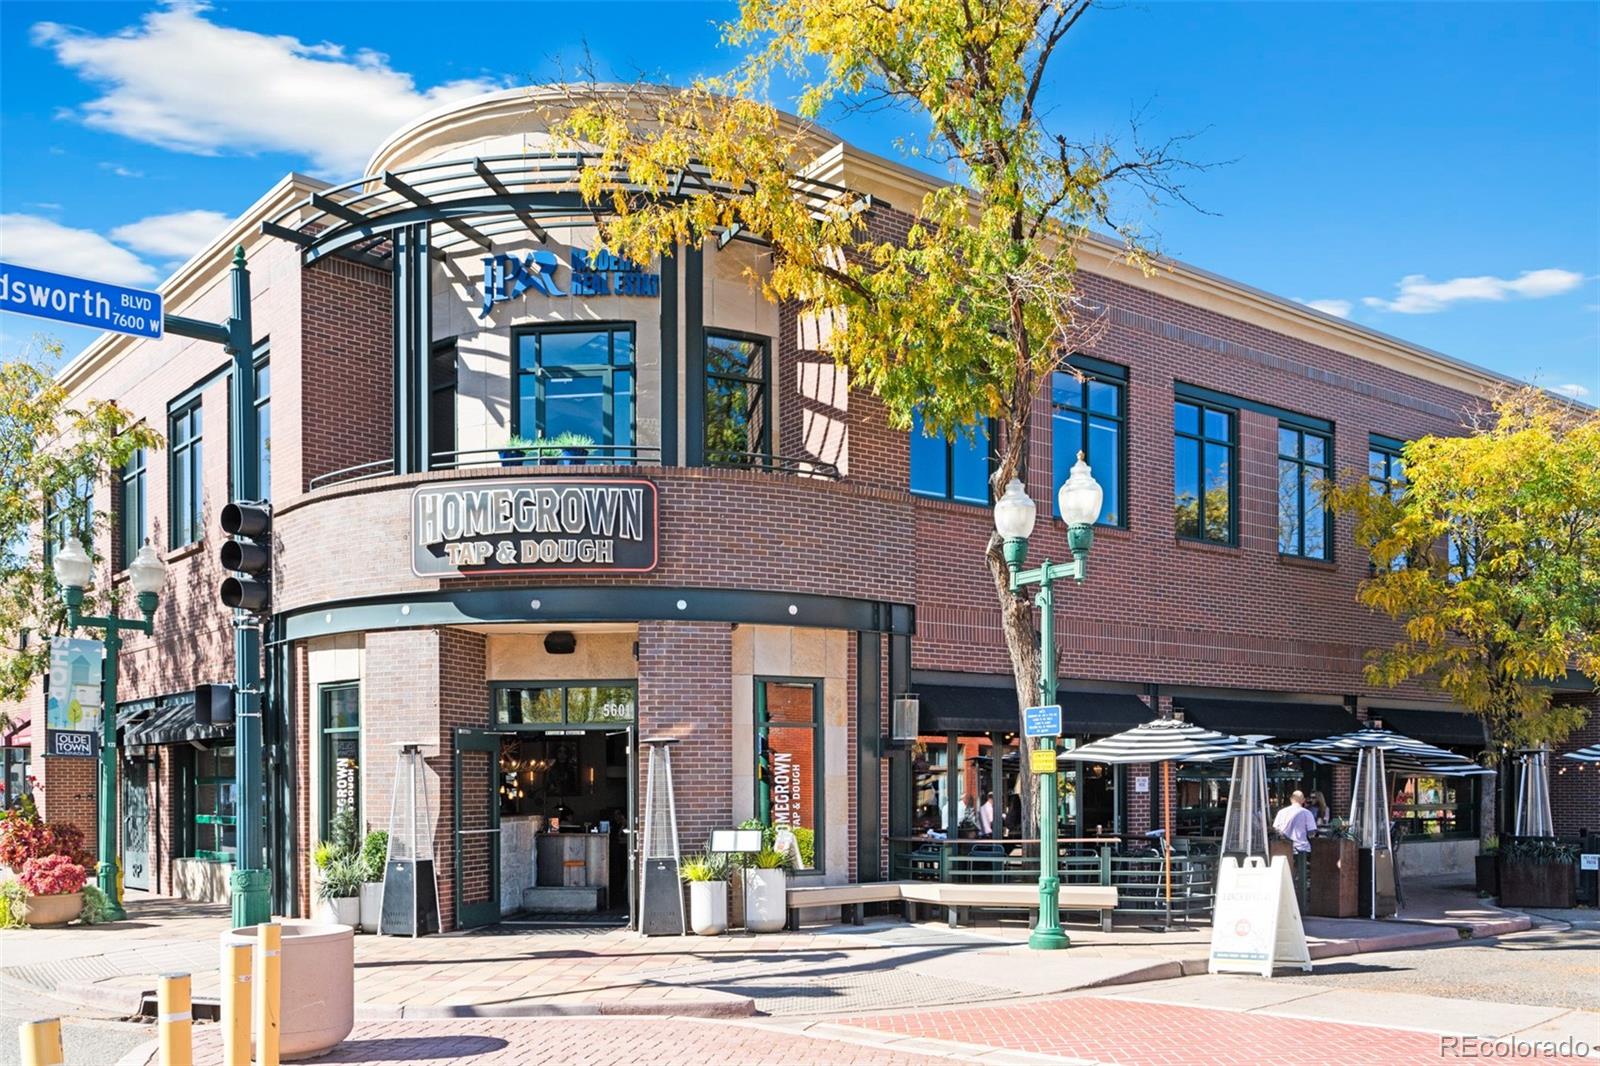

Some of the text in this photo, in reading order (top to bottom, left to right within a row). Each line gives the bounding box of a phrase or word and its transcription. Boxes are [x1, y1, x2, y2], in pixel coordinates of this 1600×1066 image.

[571, 272, 660, 298] REAL ESTAT
[121, 294, 151, 311] BLVD
[112, 313, 160, 333] 7600 W
[418, 488, 644, 546] HOMEGROWN
[444, 539, 614, 566] TAP & DOUGH
[603, 703, 631, 719] 5601
[57, 743, 89, 752] TOWN
[59, 734, 88, 745] OLDE
[336, 757, 349, 814] EGROWN
[347, 769, 355, 803] DOUGH
[774, 753, 792, 832] OMEGROWN
[792, 764, 801, 800] DOUGH
[792, 802, 801, 810] &
